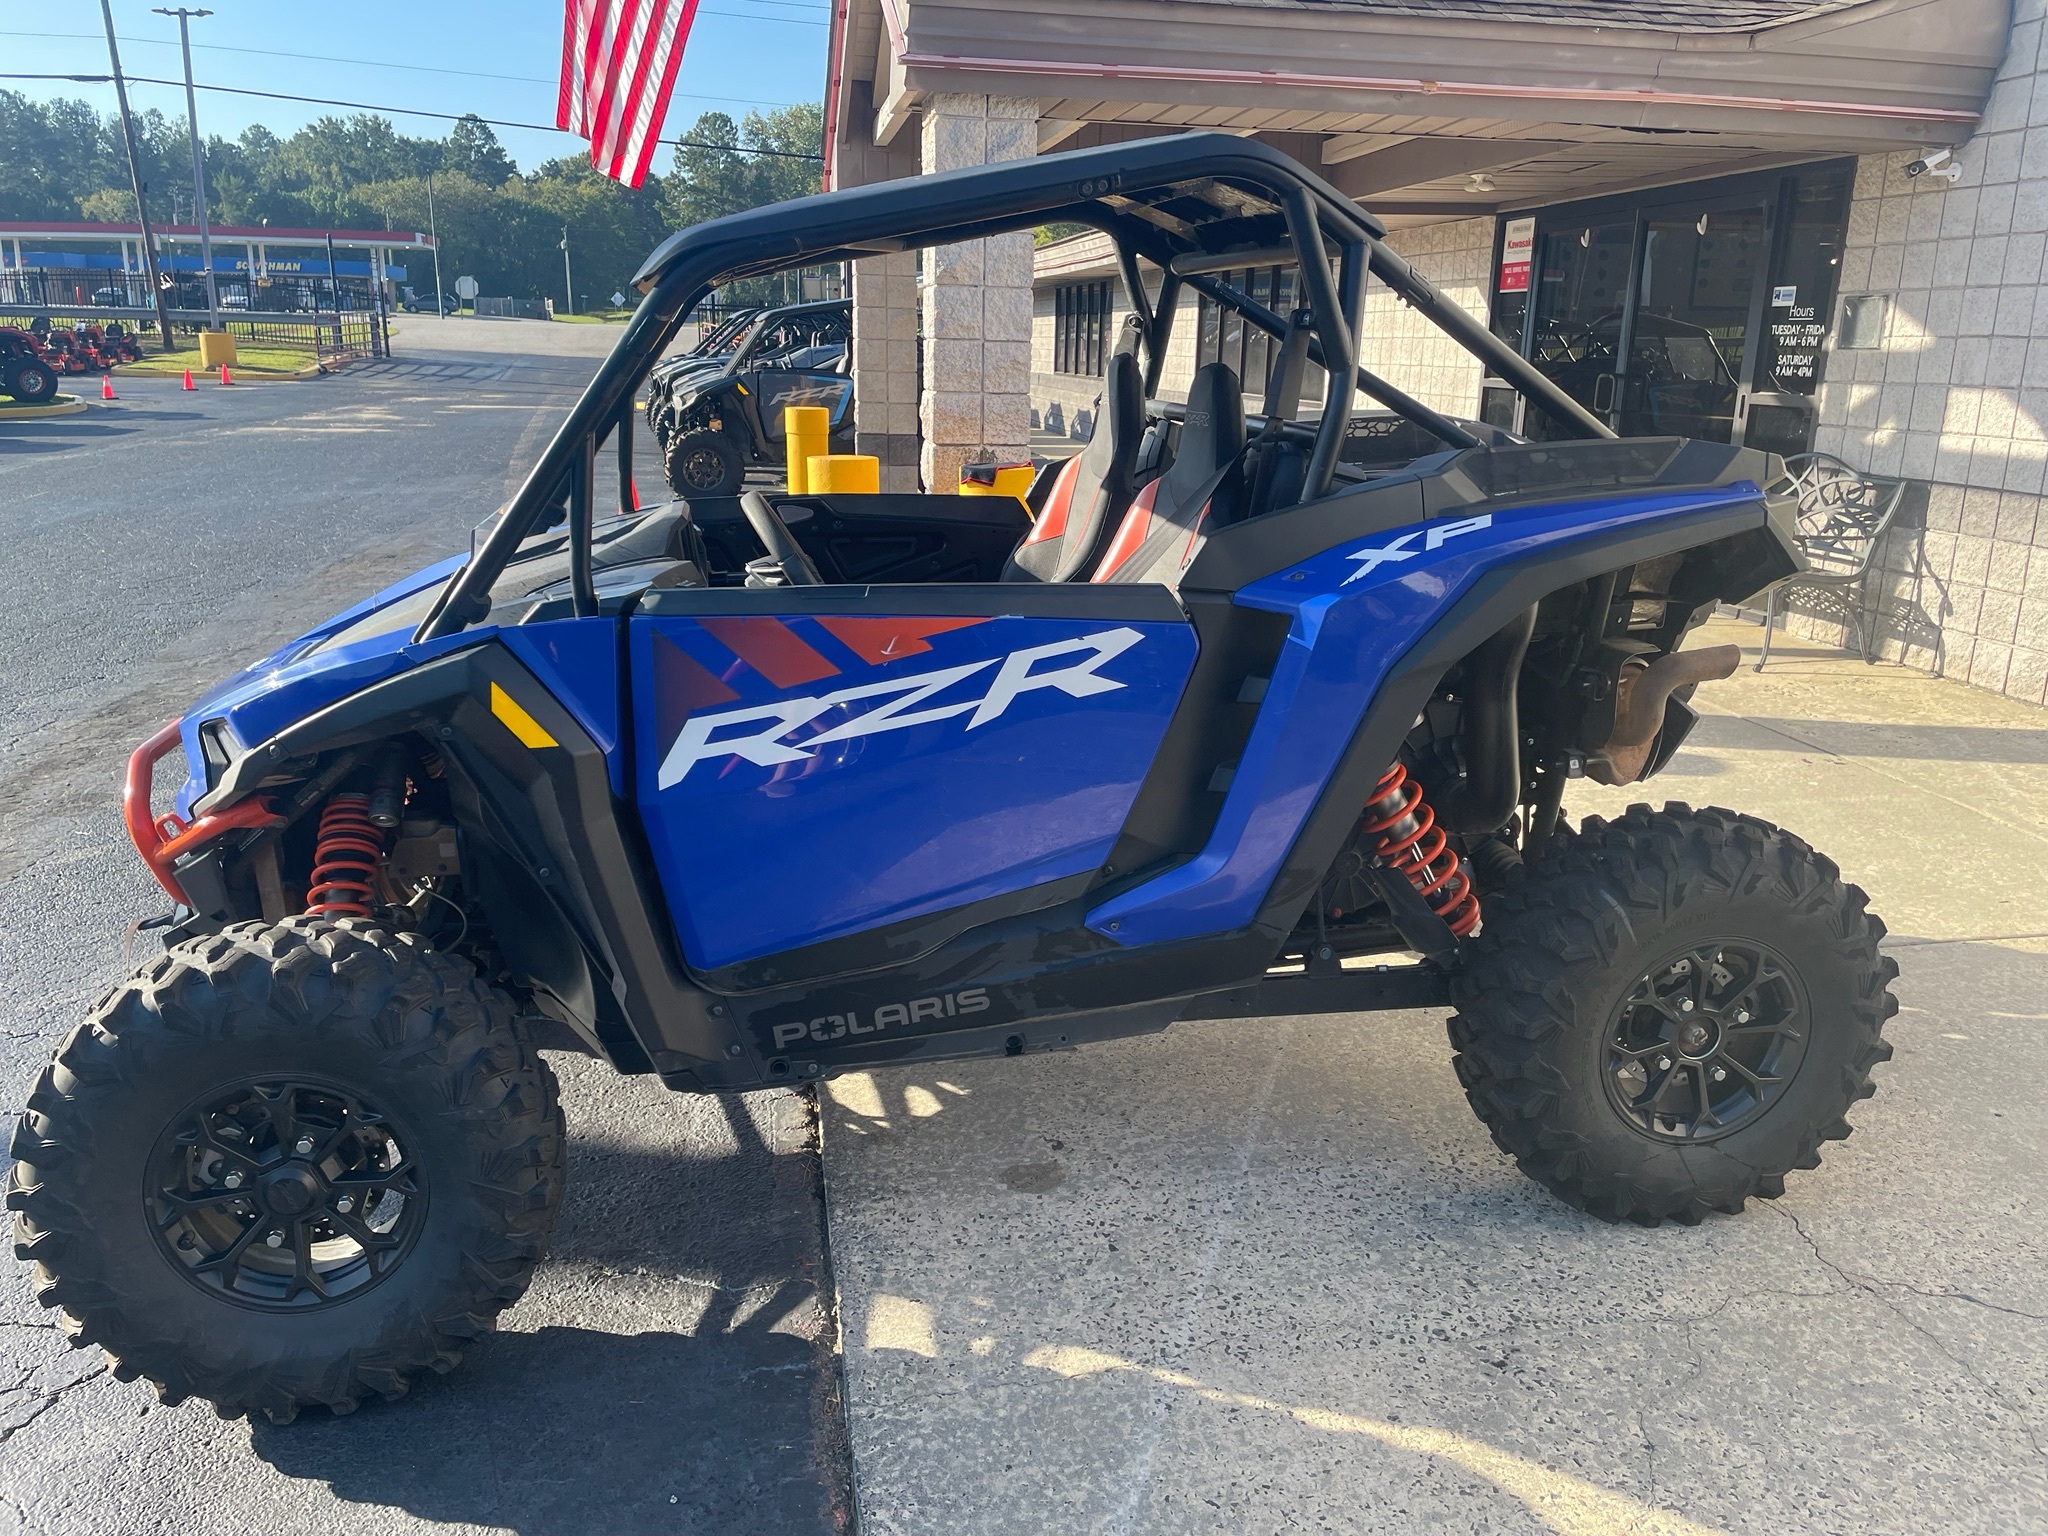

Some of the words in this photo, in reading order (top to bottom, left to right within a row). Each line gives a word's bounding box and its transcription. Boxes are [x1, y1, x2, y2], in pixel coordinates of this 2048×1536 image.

[1789, 305, 1815, 317] Hours
[1772, 325, 1801, 335] TUESDAY
[1784, 336, 1797, 347] AM
[1806, 337, 1818, 347] PM
[1778, 355, 1814, 366] SATURDAY
[1780, 367, 1793, 377] AM
[769, 384, 847, 407] RZR
[1339, 514, 1492, 587] XP
[657, 627, 1146, 791] RZR
[772, 987, 990, 1049] POLARIS
